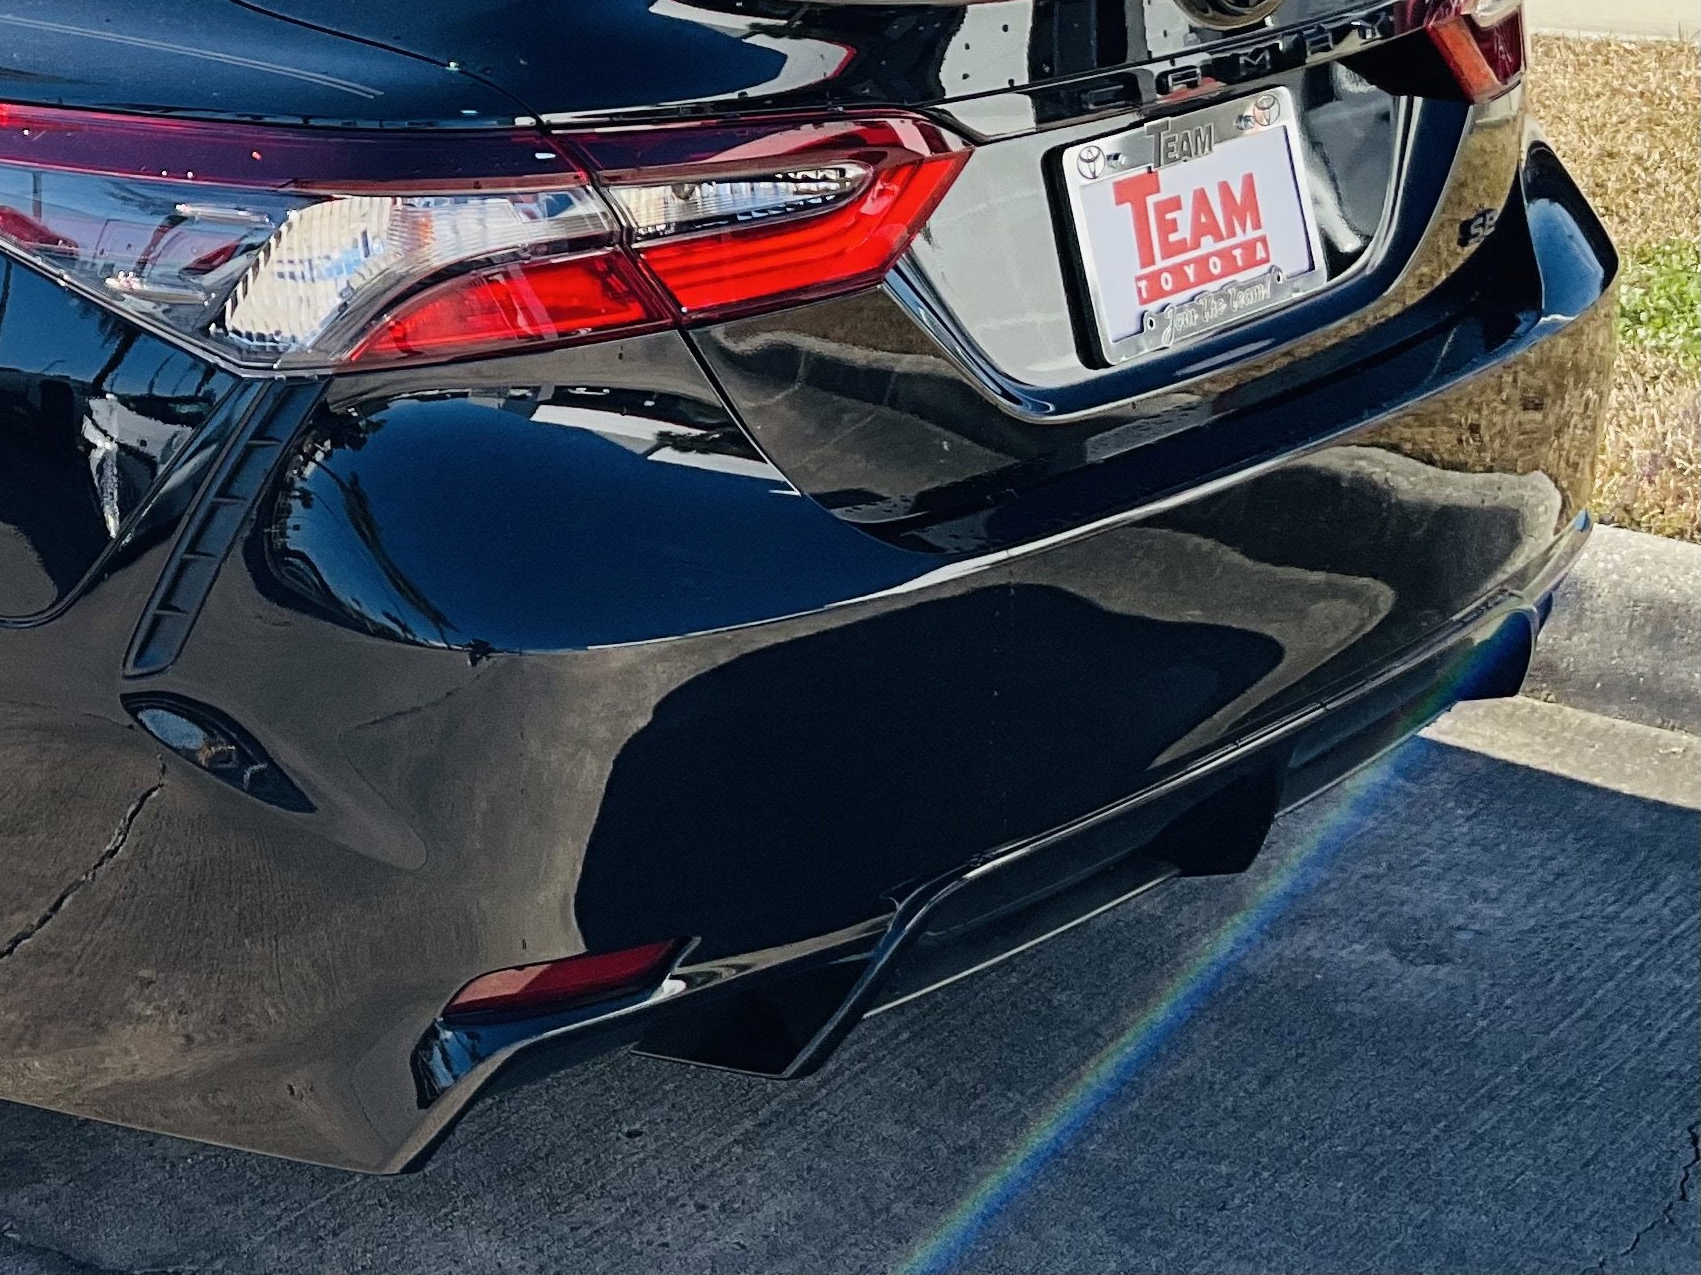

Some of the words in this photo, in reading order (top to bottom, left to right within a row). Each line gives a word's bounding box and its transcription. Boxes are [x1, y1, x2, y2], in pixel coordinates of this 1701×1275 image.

[1082, 12, 1390, 111] CAMRY
[1147, 118, 1215, 168] TEAM
[1112, 169, 1263, 270] TEAM
[1136, 241, 1267, 299] TOYOTA
